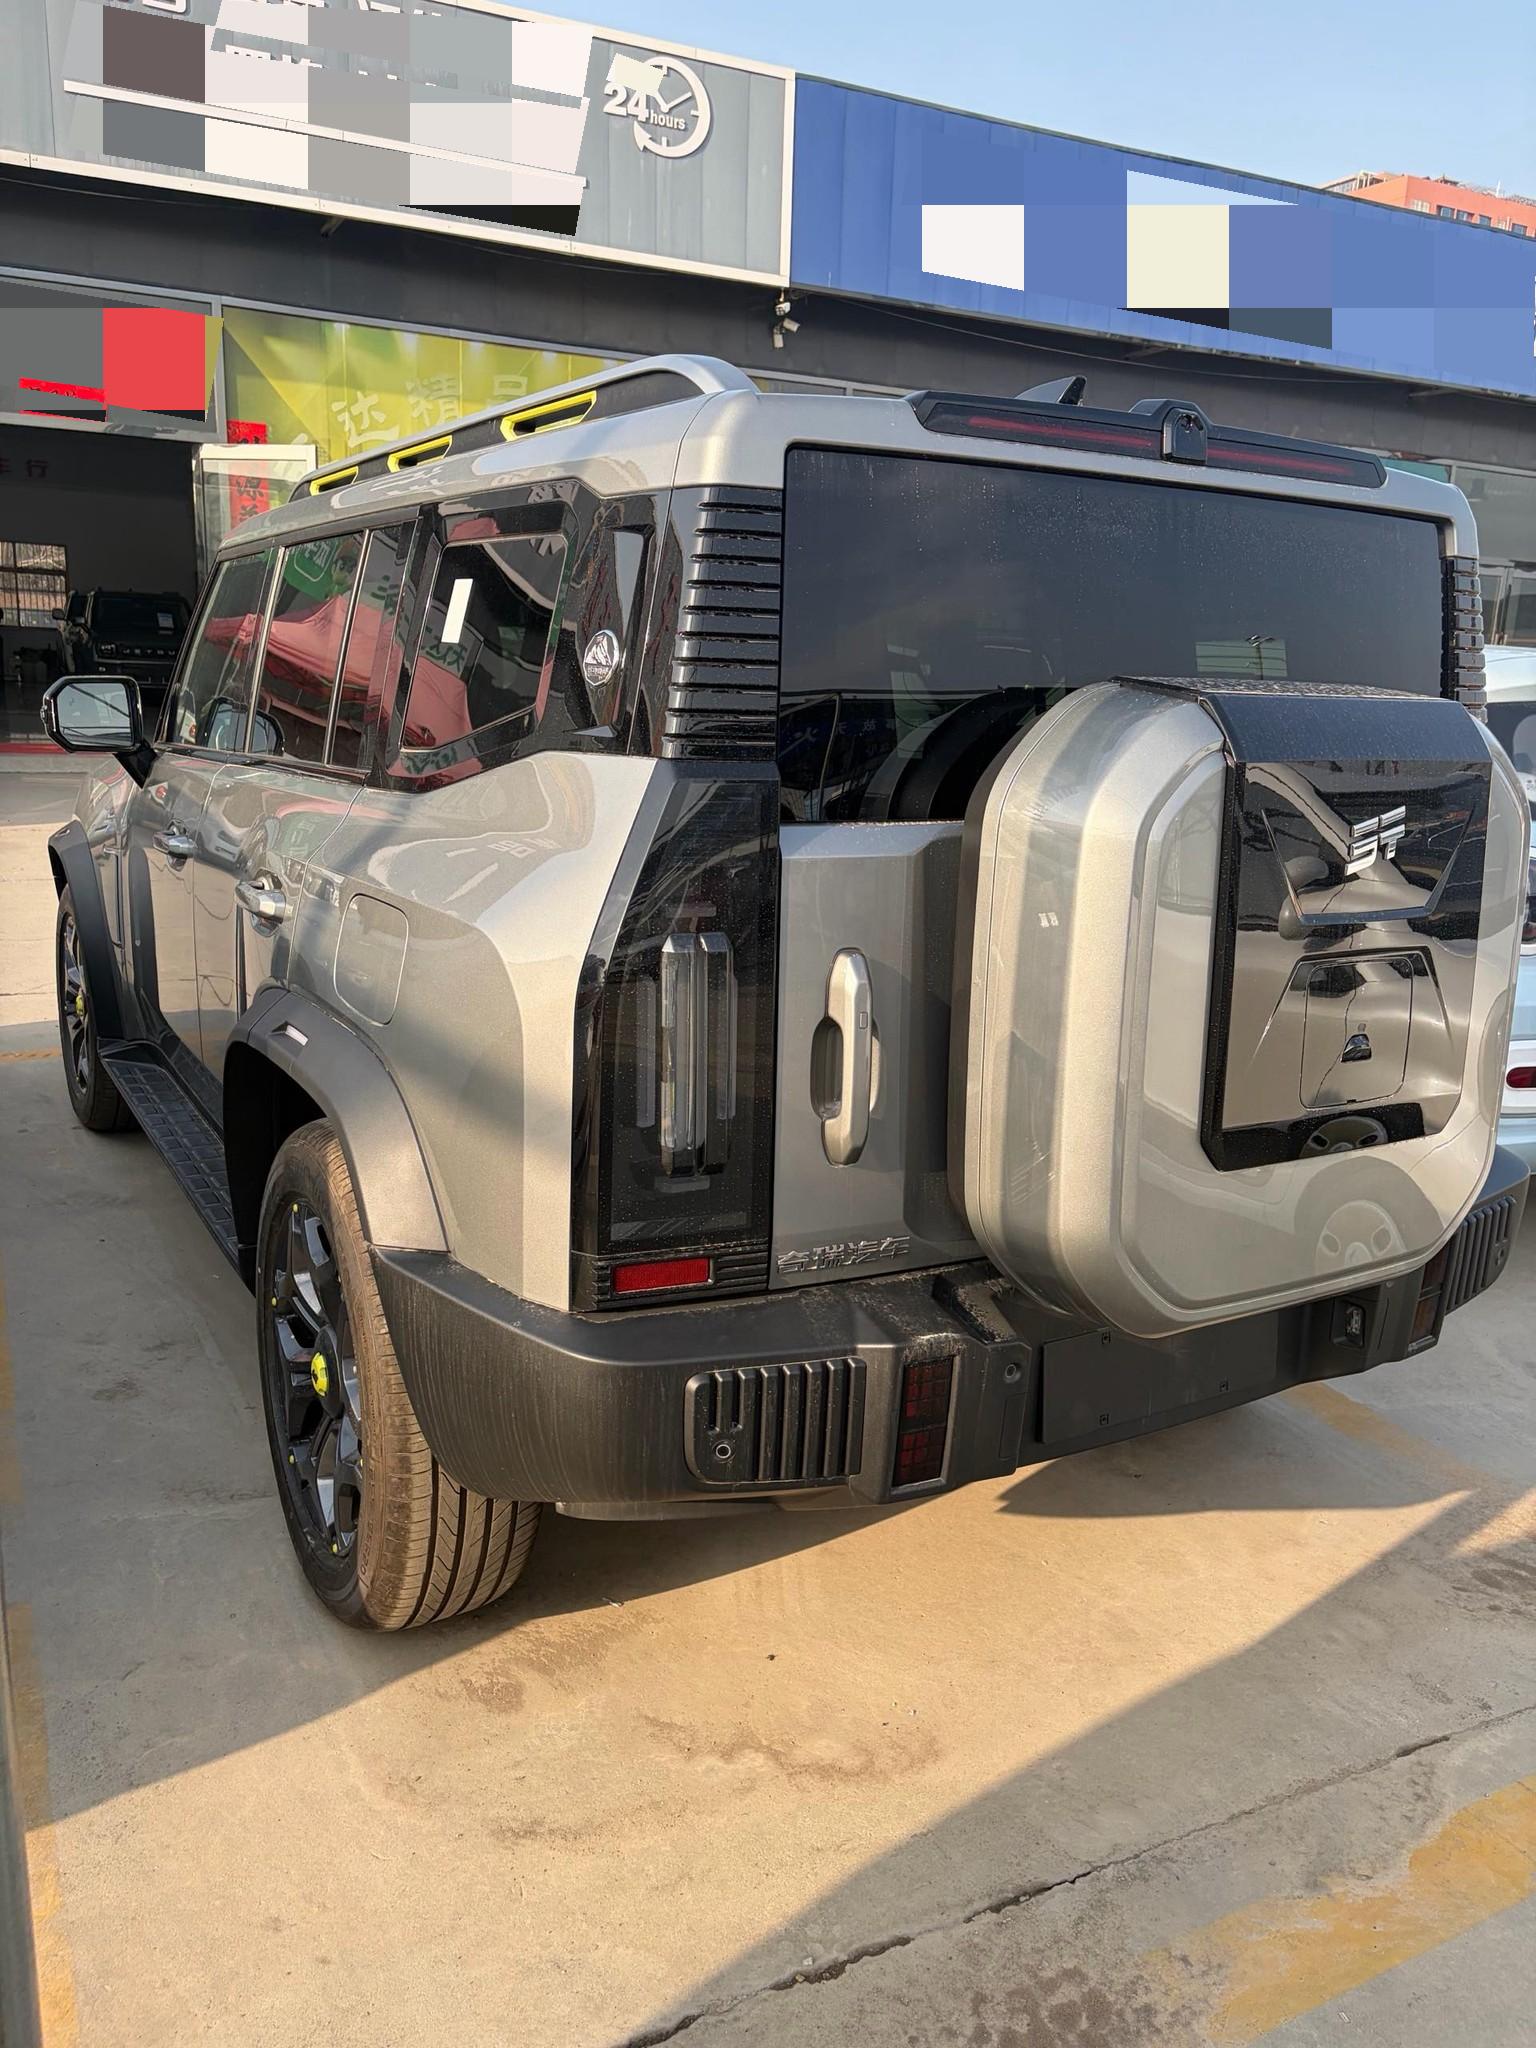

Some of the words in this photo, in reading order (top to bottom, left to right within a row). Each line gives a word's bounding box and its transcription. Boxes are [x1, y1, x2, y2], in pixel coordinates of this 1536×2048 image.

[650, 109, 687, 130] hours
[777, 1236, 911, 1274] 奇瑞汽车
